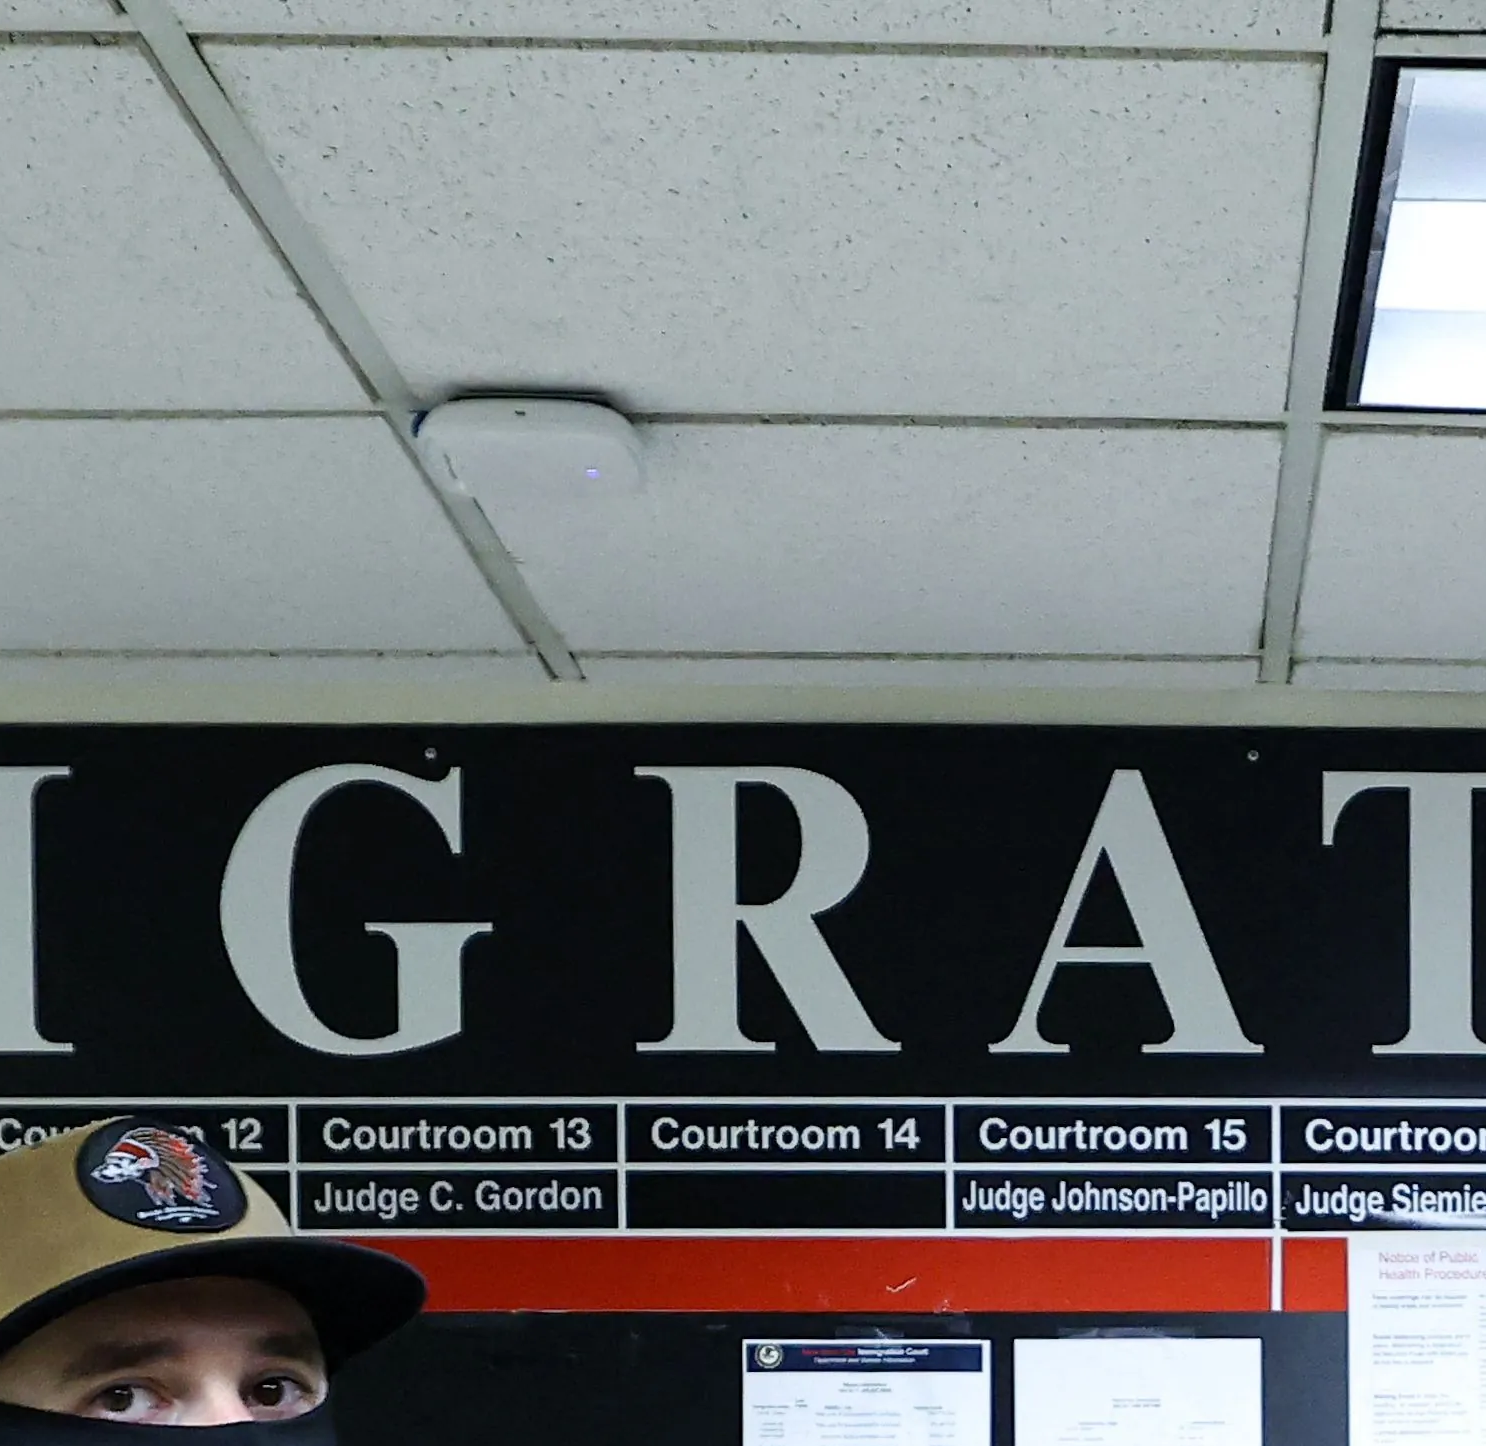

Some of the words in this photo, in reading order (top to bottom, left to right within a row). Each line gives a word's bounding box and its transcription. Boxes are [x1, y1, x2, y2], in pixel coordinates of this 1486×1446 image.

[222, 1118, 262, 1149] 12
[323, 1118, 531, 1150] Courtroom
[550, 1118, 591, 1149] 13
[652, 1117, 860, 1150] Courtroom
[878, 1118, 920, 1149] 14
[980, 1118, 1187, 1150] Courtroom
[1205, 1119, 1246, 1150] 15
[315, 1182, 419, 1219] Judge
[430, 1181, 463, 1211] C.
[476, 1180, 602, 1210] Gordon
[963, 1181, 1044, 1218] Judge
[1052, 1181, 1267, 1219] Johnson-Papillo
[1294, 1185, 1384, 1221] Judge
